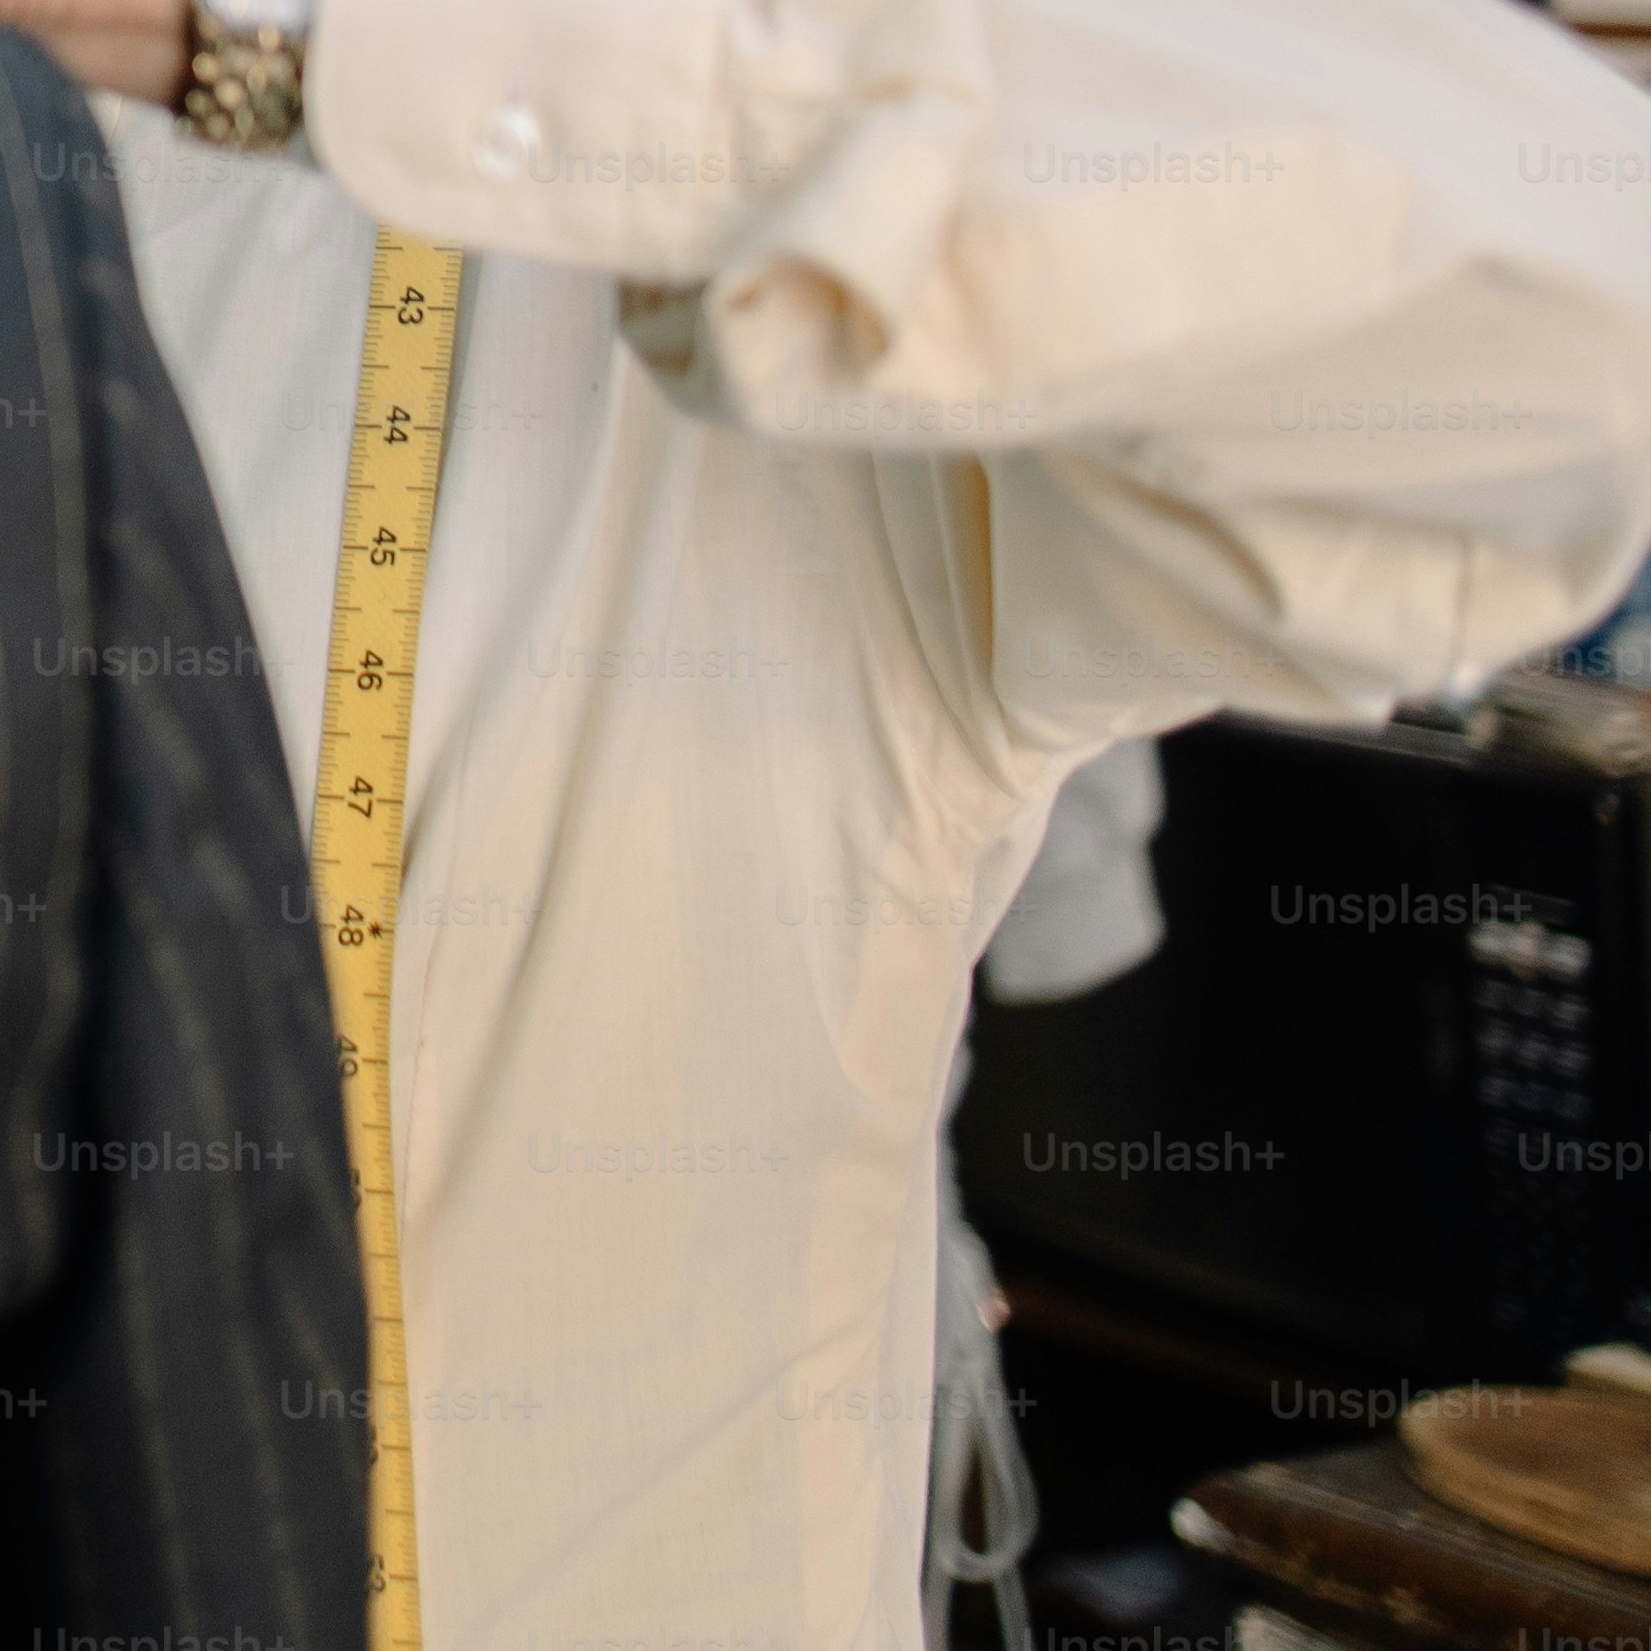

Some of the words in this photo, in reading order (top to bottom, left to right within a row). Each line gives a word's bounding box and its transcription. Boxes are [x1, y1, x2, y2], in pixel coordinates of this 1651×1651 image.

[397, 286, 426, 326] 43
[384, 406, 411, 445] 44
[370, 526, 397, 567] 45
[357, 650, 384, 692] 46
[347, 776, 374, 819] 47
[339, 904, 365, 948] 48
